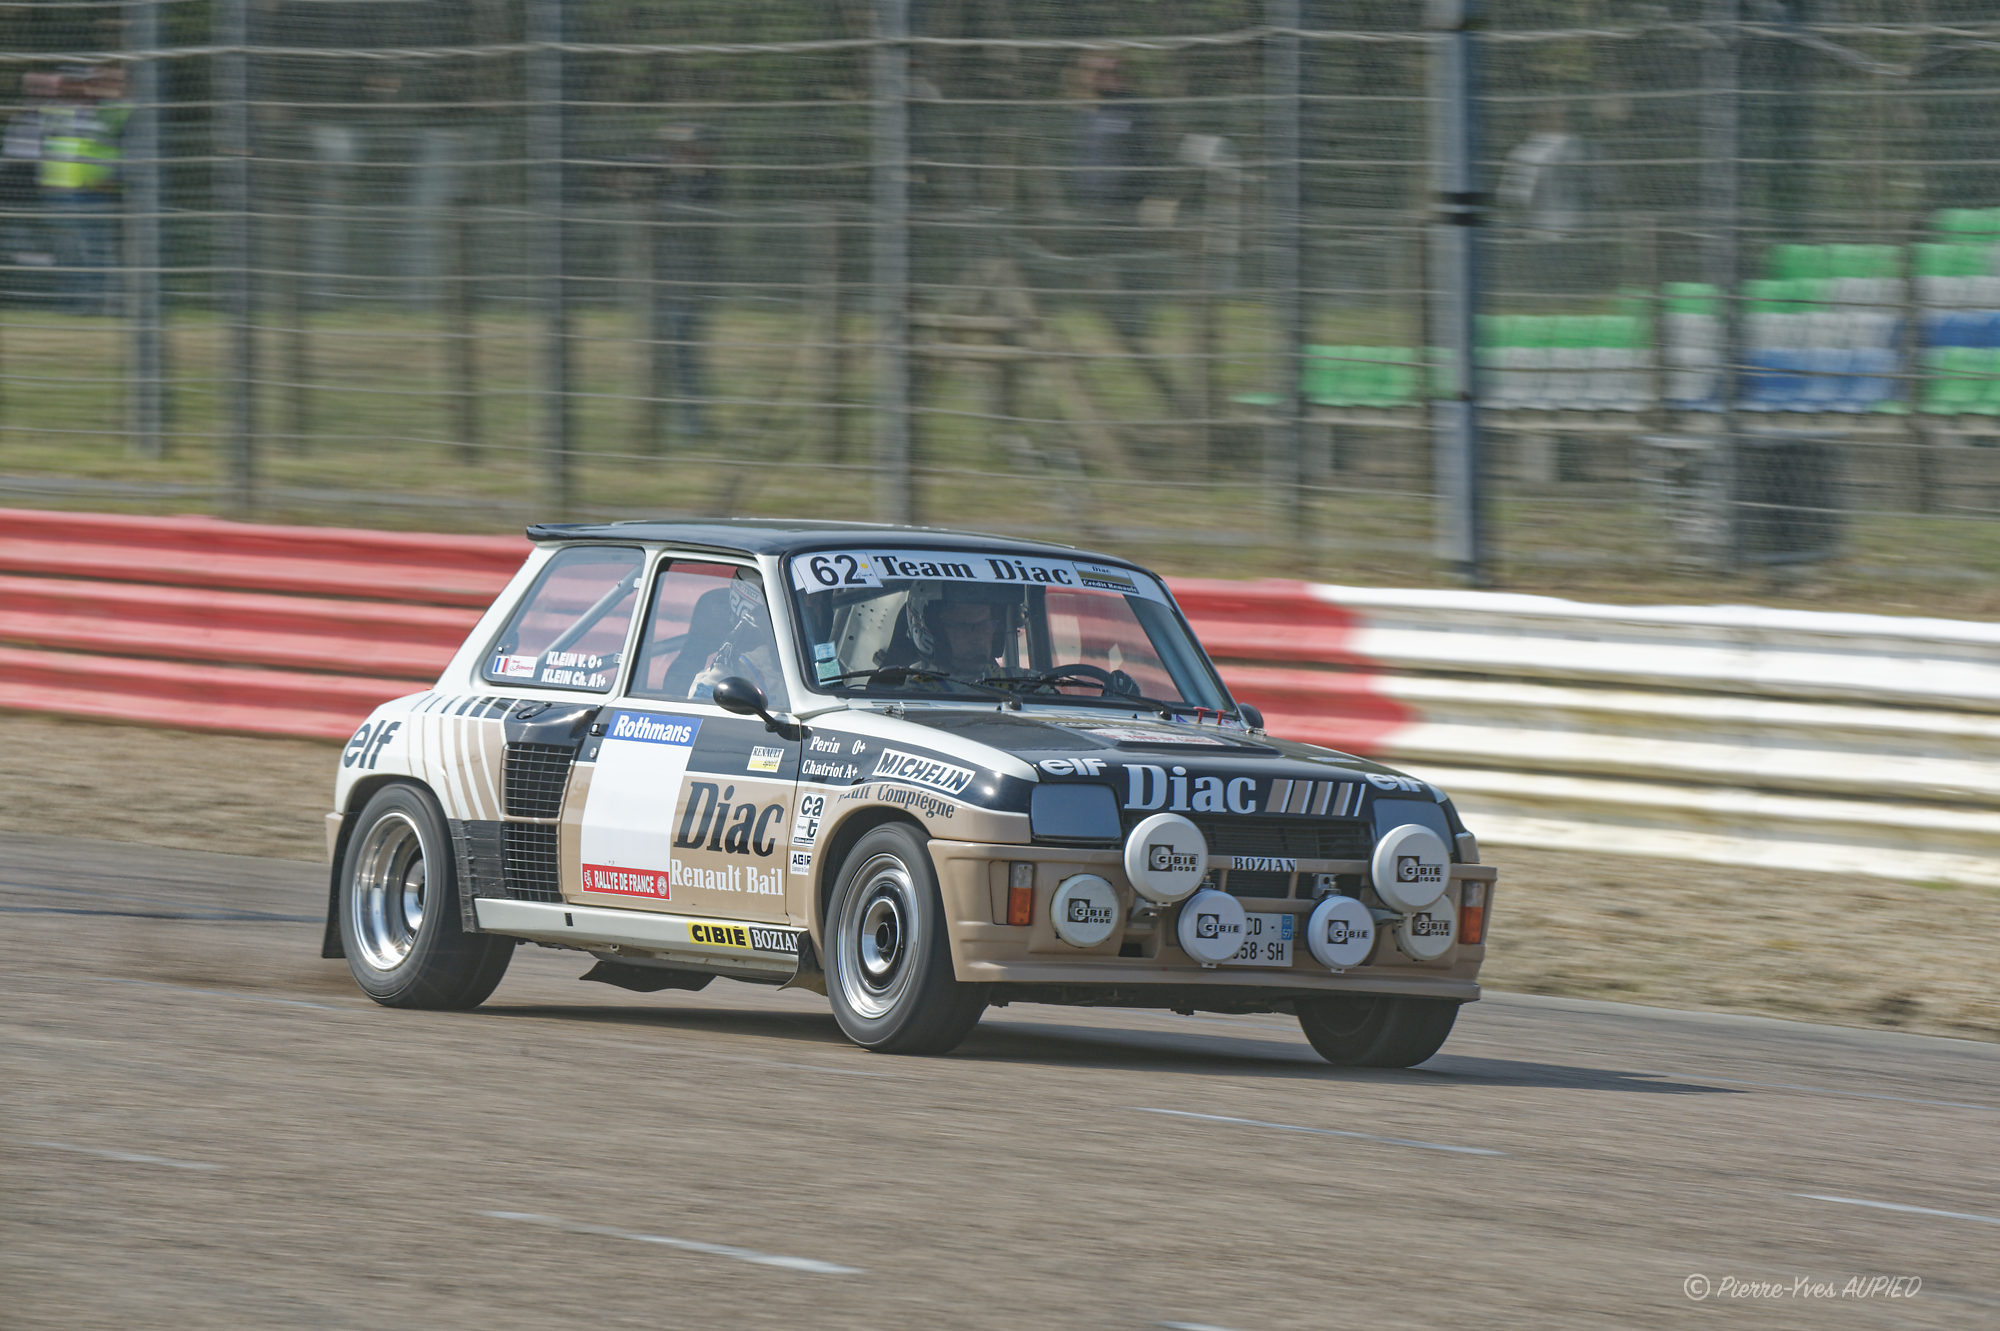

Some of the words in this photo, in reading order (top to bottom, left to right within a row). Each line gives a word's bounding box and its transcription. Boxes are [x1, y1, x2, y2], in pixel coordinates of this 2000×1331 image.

[810, 554, 867, 587] 62
[873, 555, 977, 578] Team
[985, 558, 1073, 585] Diac
[546, 651, 575, 667] KLEIN
[575, 653, 586, 668] V.
[541, 668, 572, 685] KLEIN
[572, 671, 586, 687] Ch.
[613, 714, 692, 744] Rothmans
[343, 719, 402, 770] elf
[809, 736, 841, 754] Perin
[802, 759, 844, 777] Chatriot
[844, 764, 858, 779] A+
[875, 752, 972, 793] MICHELIN
[1039, 758, 1107, 776] elf
[1122, 763, 1256, 815] Diac
[1365, 773, 1424, 792] elf
[801, 795, 824, 817] ca
[673, 781, 785, 858] Diac
[1233, 856, 1297, 873] BOZIAN
[594, 870, 619, 890] RALLYE
[619, 872, 628, 891] DE
[628, 873, 655, 894] FRANCE
[670, 859, 742, 893] Renault
[745, 866, 784, 896] Bail
[751, 929, 798, 952] BOZIAN
